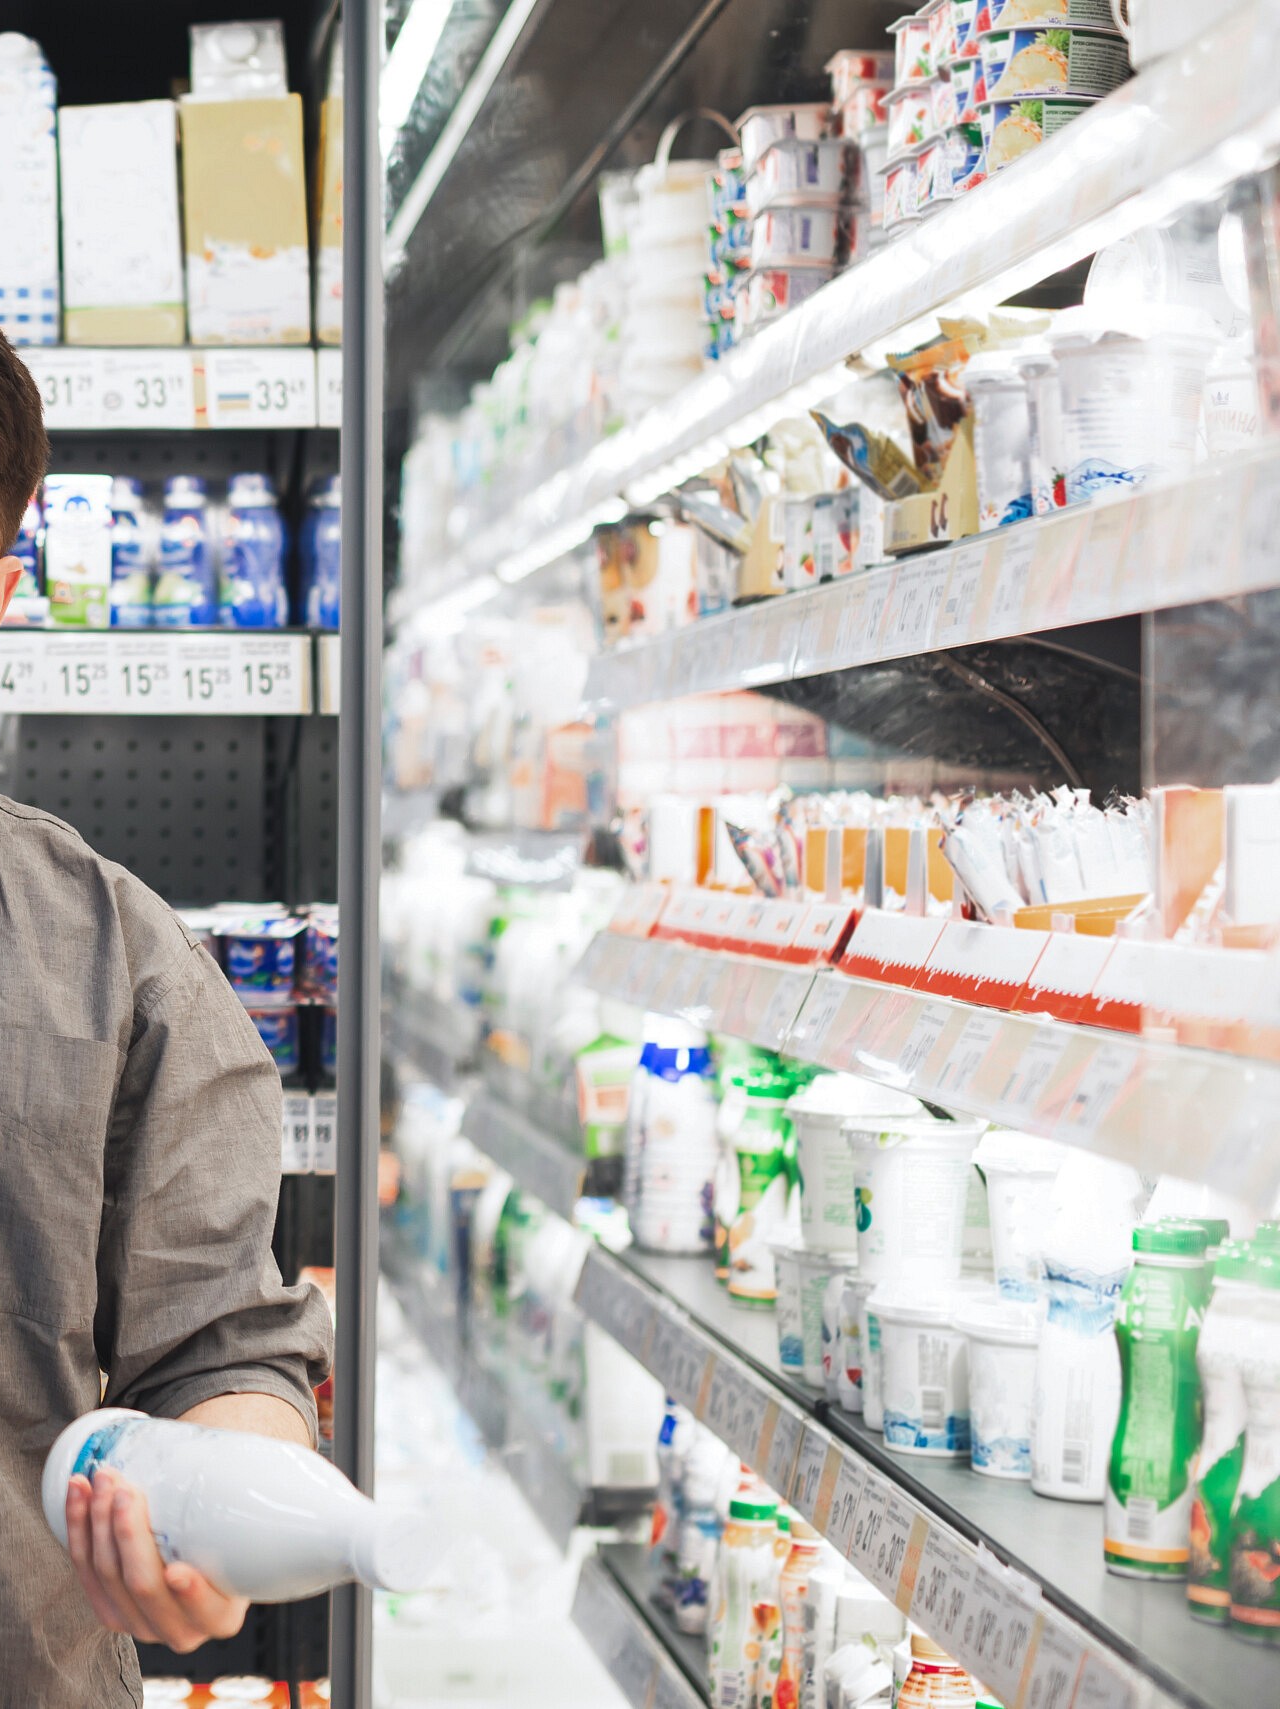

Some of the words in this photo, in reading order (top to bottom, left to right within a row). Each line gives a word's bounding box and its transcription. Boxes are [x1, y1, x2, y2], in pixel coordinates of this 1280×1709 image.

[61, 664, 90, 695] 15
[122, 664, 152, 695] 15
[185, 668, 214, 700] 15
[244, 663, 273, 695] 15
